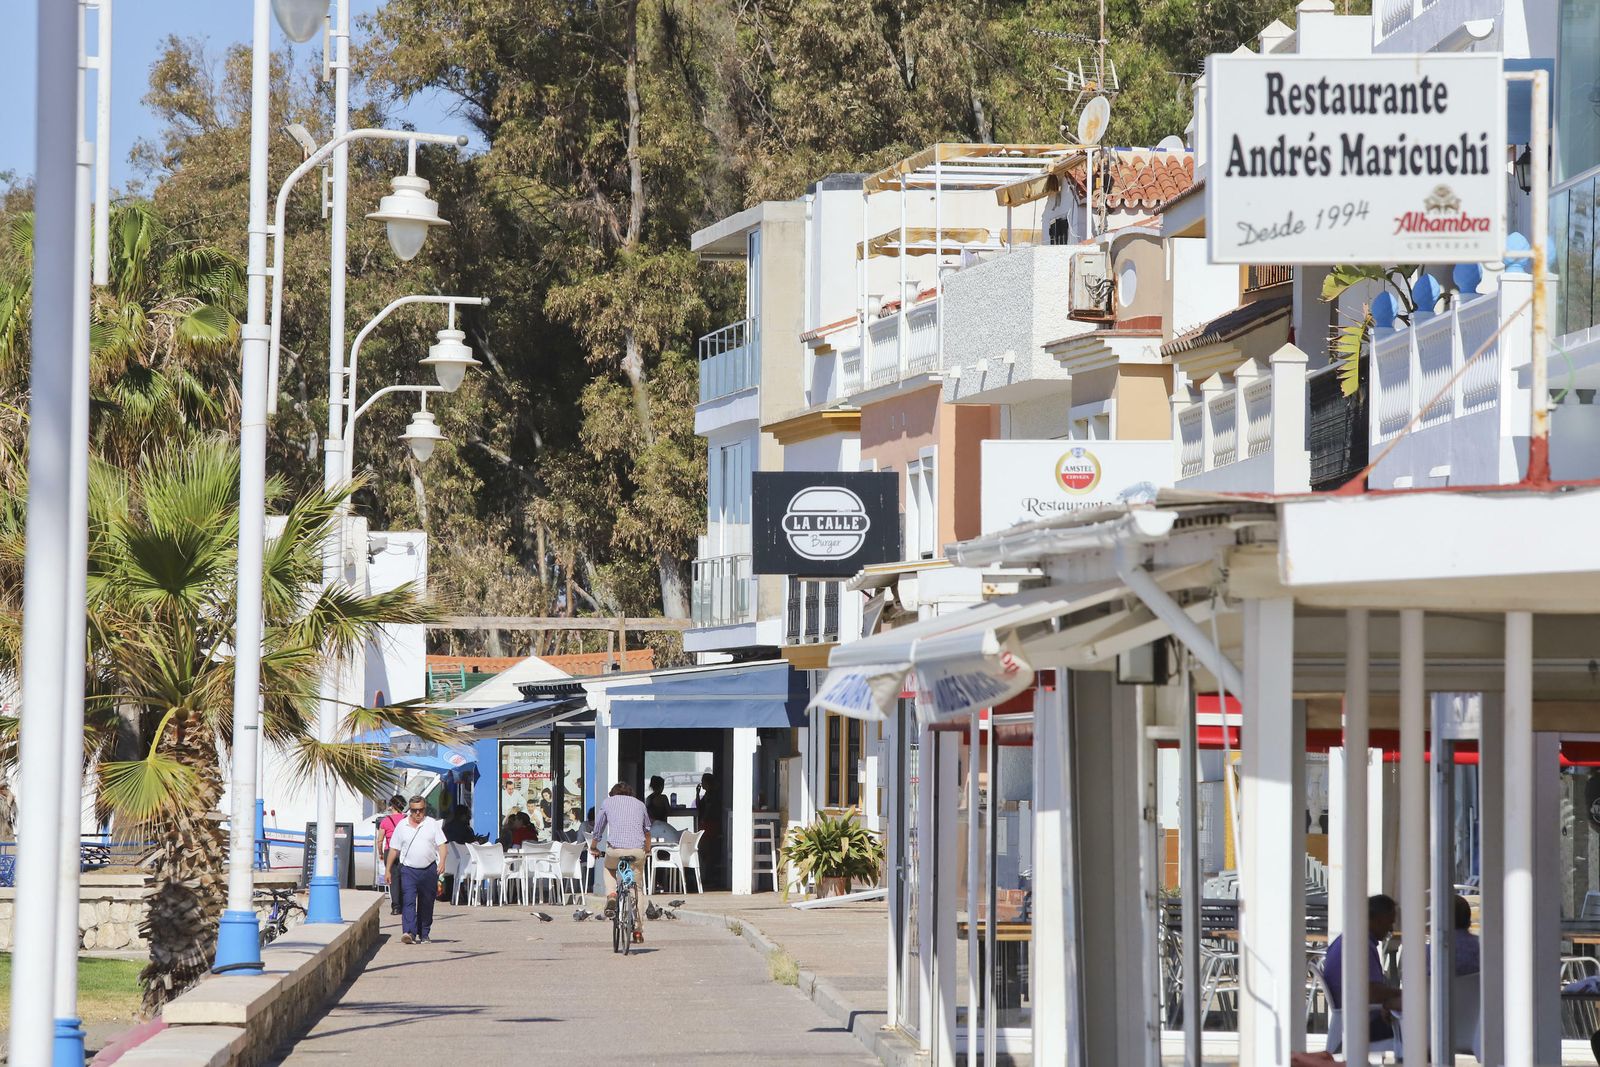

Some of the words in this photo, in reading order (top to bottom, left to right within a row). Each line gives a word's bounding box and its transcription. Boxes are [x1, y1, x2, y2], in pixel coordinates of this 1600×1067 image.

[1266, 72, 1448, 115] Restaurante
[1225, 132, 1331, 177] Andrés
[1340, 131, 1490, 177] Maricuchi
[1237, 209, 1306, 246] Desde
[1314, 198, 1370, 231] 1994
[1392, 210, 1491, 236] Alhambra
[1063, 465, 1093, 473] AMSTEL
[792, 516, 811, 531] LA
[816, 516, 861, 531] CALLE
[809, 533, 842, 554] Burger
